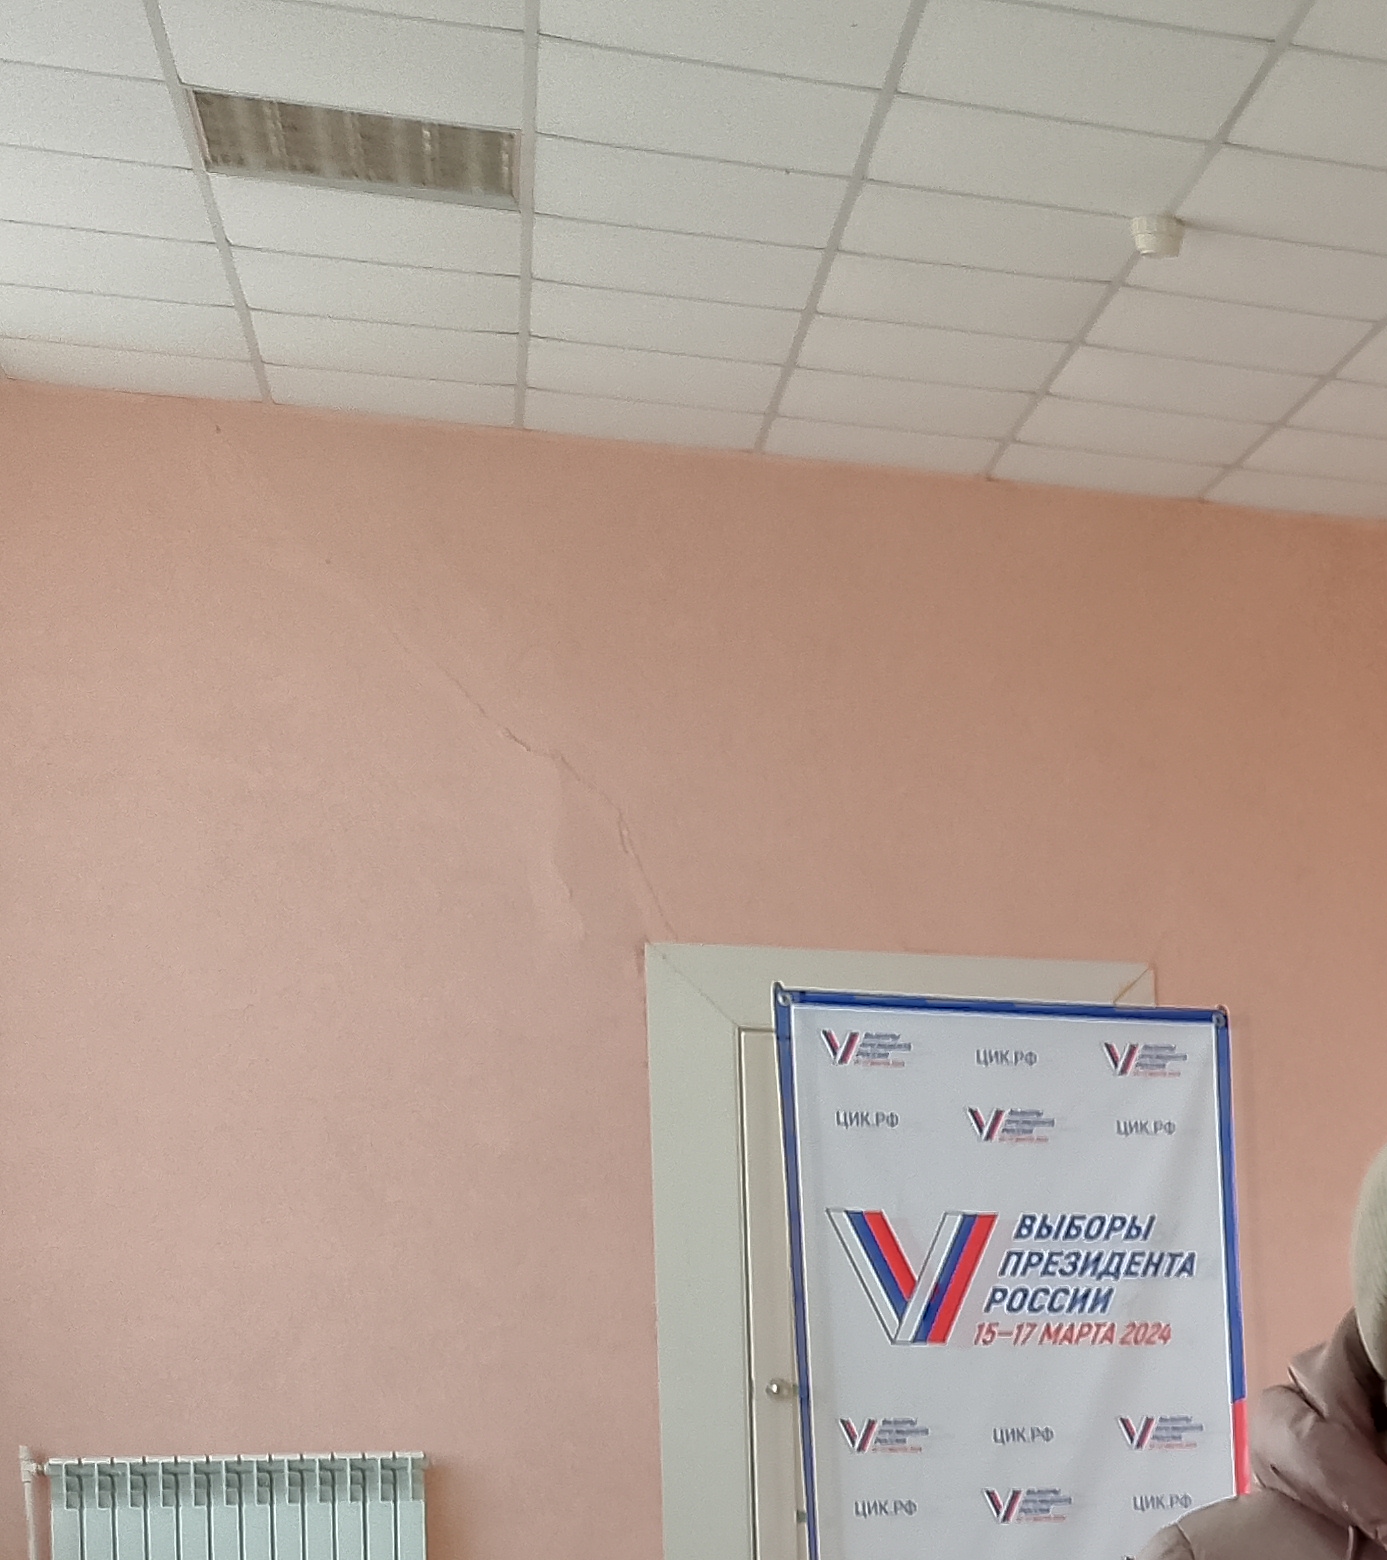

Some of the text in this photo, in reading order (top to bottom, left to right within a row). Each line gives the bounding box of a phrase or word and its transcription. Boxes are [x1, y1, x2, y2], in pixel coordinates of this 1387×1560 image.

[977, 1049, 1037, 1067] ЦИК.РФ
[836, 1111, 898, 1129] ЦИК.РФ
[1117, 1120, 1175, 1137] ЦИК.РФ
[1014, 1214, 1155, 1241] ВЫБОРЫ
[999, 1251, 1195, 1281] ПРЕЗИДЕНТА
[984, 1287, 1114, 1314] РОССИИ
[1039, 1324, 1115, 1345] МАРТА
[1120, 1324, 1171, 1345] 2024
[993, 1427, 1053, 1445] ЦИК.РФ
[855, 1500, 916, 1519] ЦИК.РФ
[1133, 1494, 1193, 1512] ЦИК.РФ
